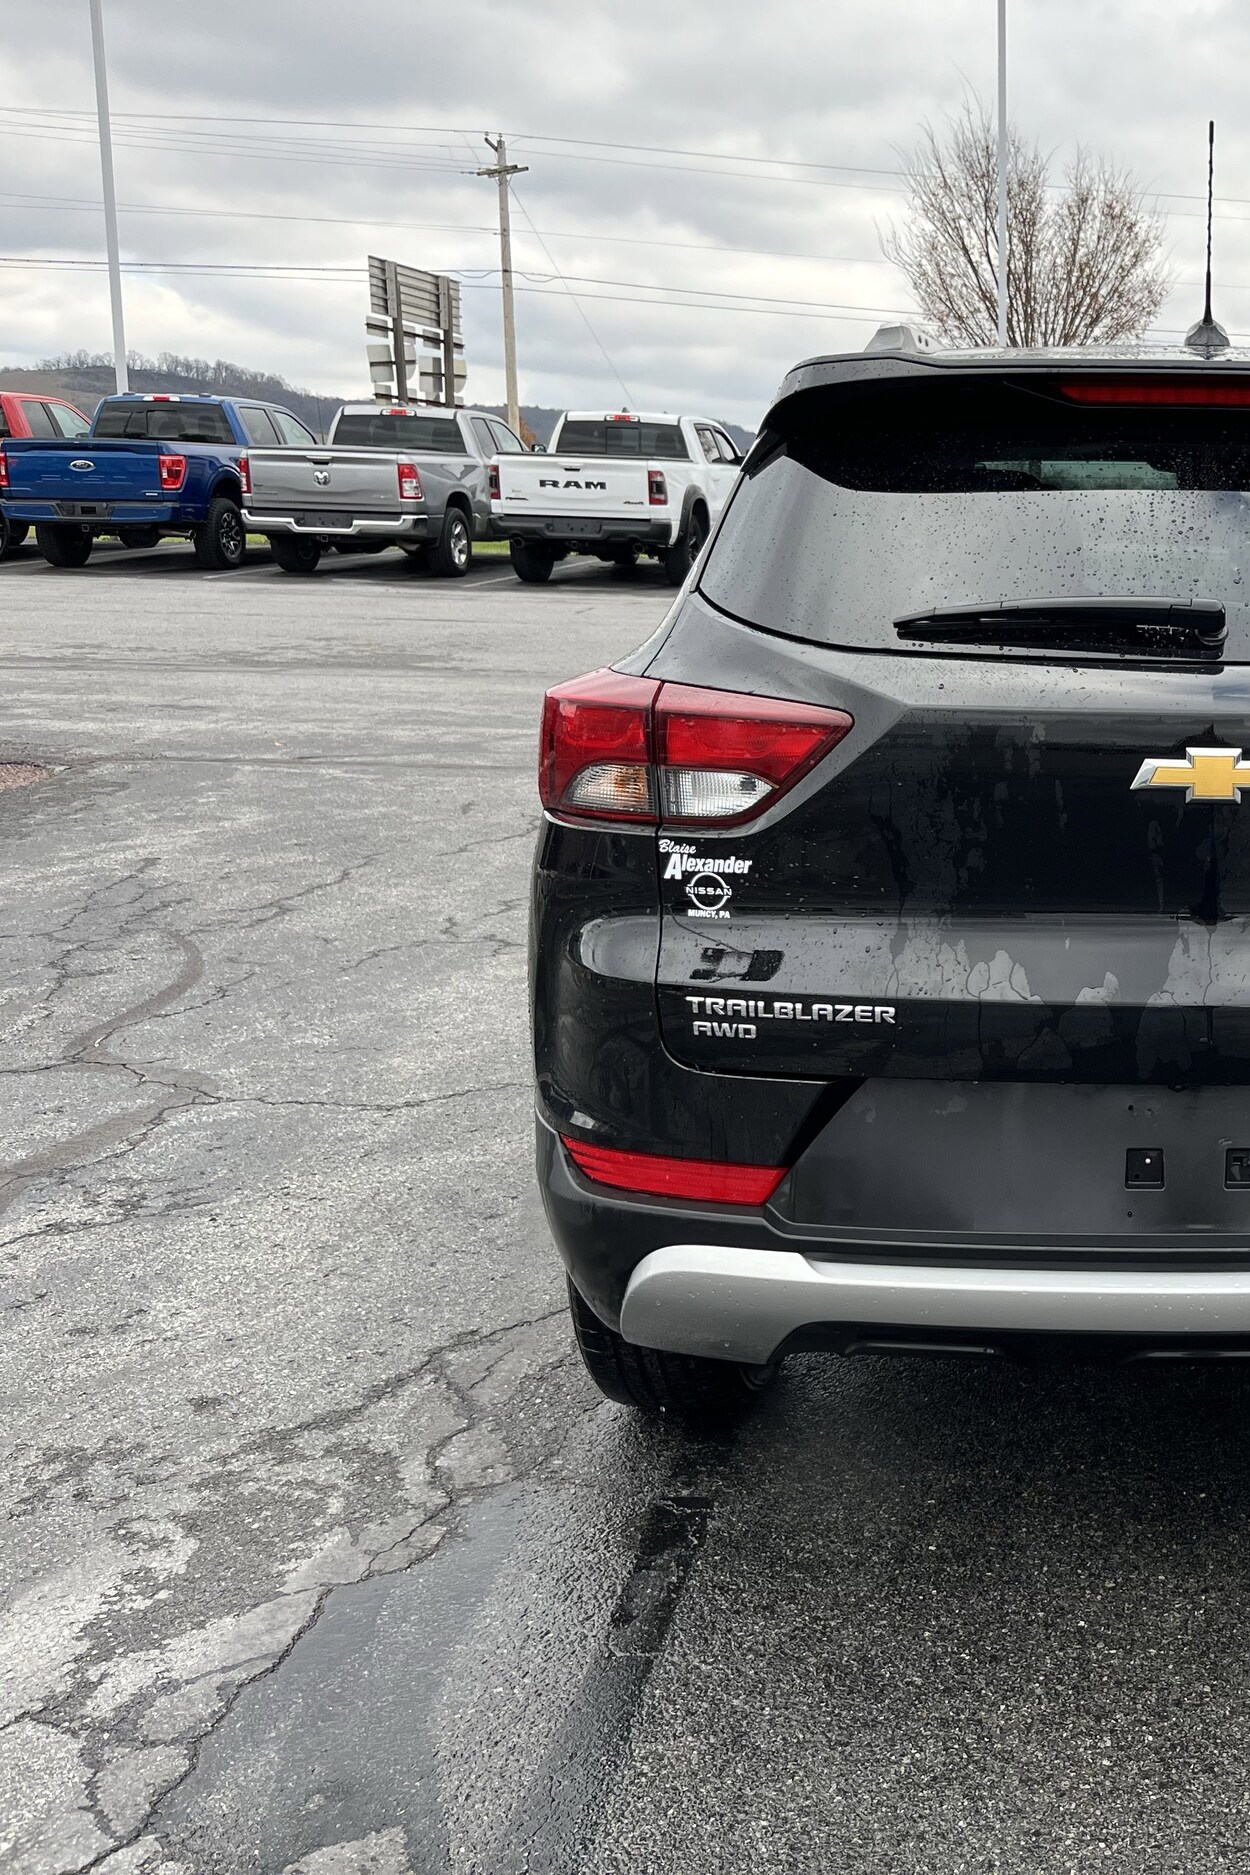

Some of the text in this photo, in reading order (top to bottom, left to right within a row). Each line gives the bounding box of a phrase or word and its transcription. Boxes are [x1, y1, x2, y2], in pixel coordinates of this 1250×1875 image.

[539, 479, 607, 490] RAM
[658, 838, 697, 854] Blaise
[663, 853, 753, 880] Alexander
[685, 886, 732, 896] NISSAN
[687, 908, 731, 920] MUNCY, PA
[685, 996, 896, 1024] TRAILBLAZER
[693, 1020, 757, 1039] AWD
